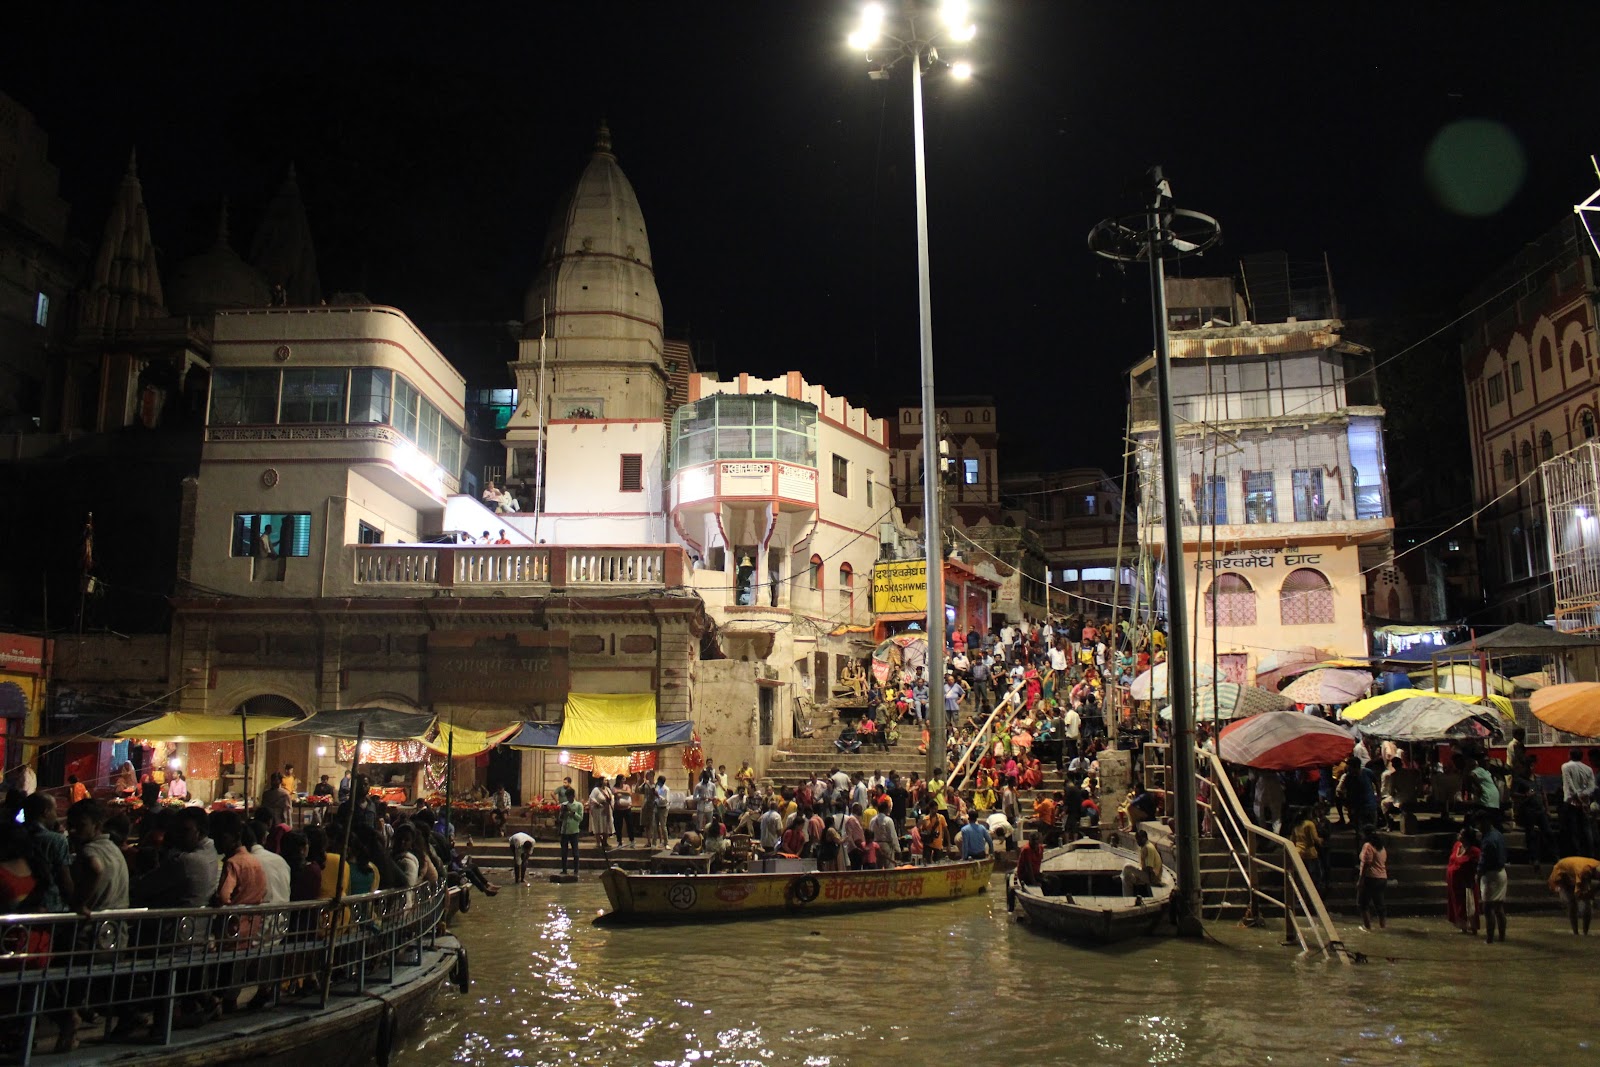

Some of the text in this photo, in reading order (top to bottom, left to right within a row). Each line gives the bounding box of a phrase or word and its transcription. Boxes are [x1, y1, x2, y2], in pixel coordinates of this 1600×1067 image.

[1284, 554, 1322, 566] घाट
[874, 583, 928, 593] DASHASHWME
[890, 595, 914, 603] GHAT
[672, 886, 692, 903] 29
